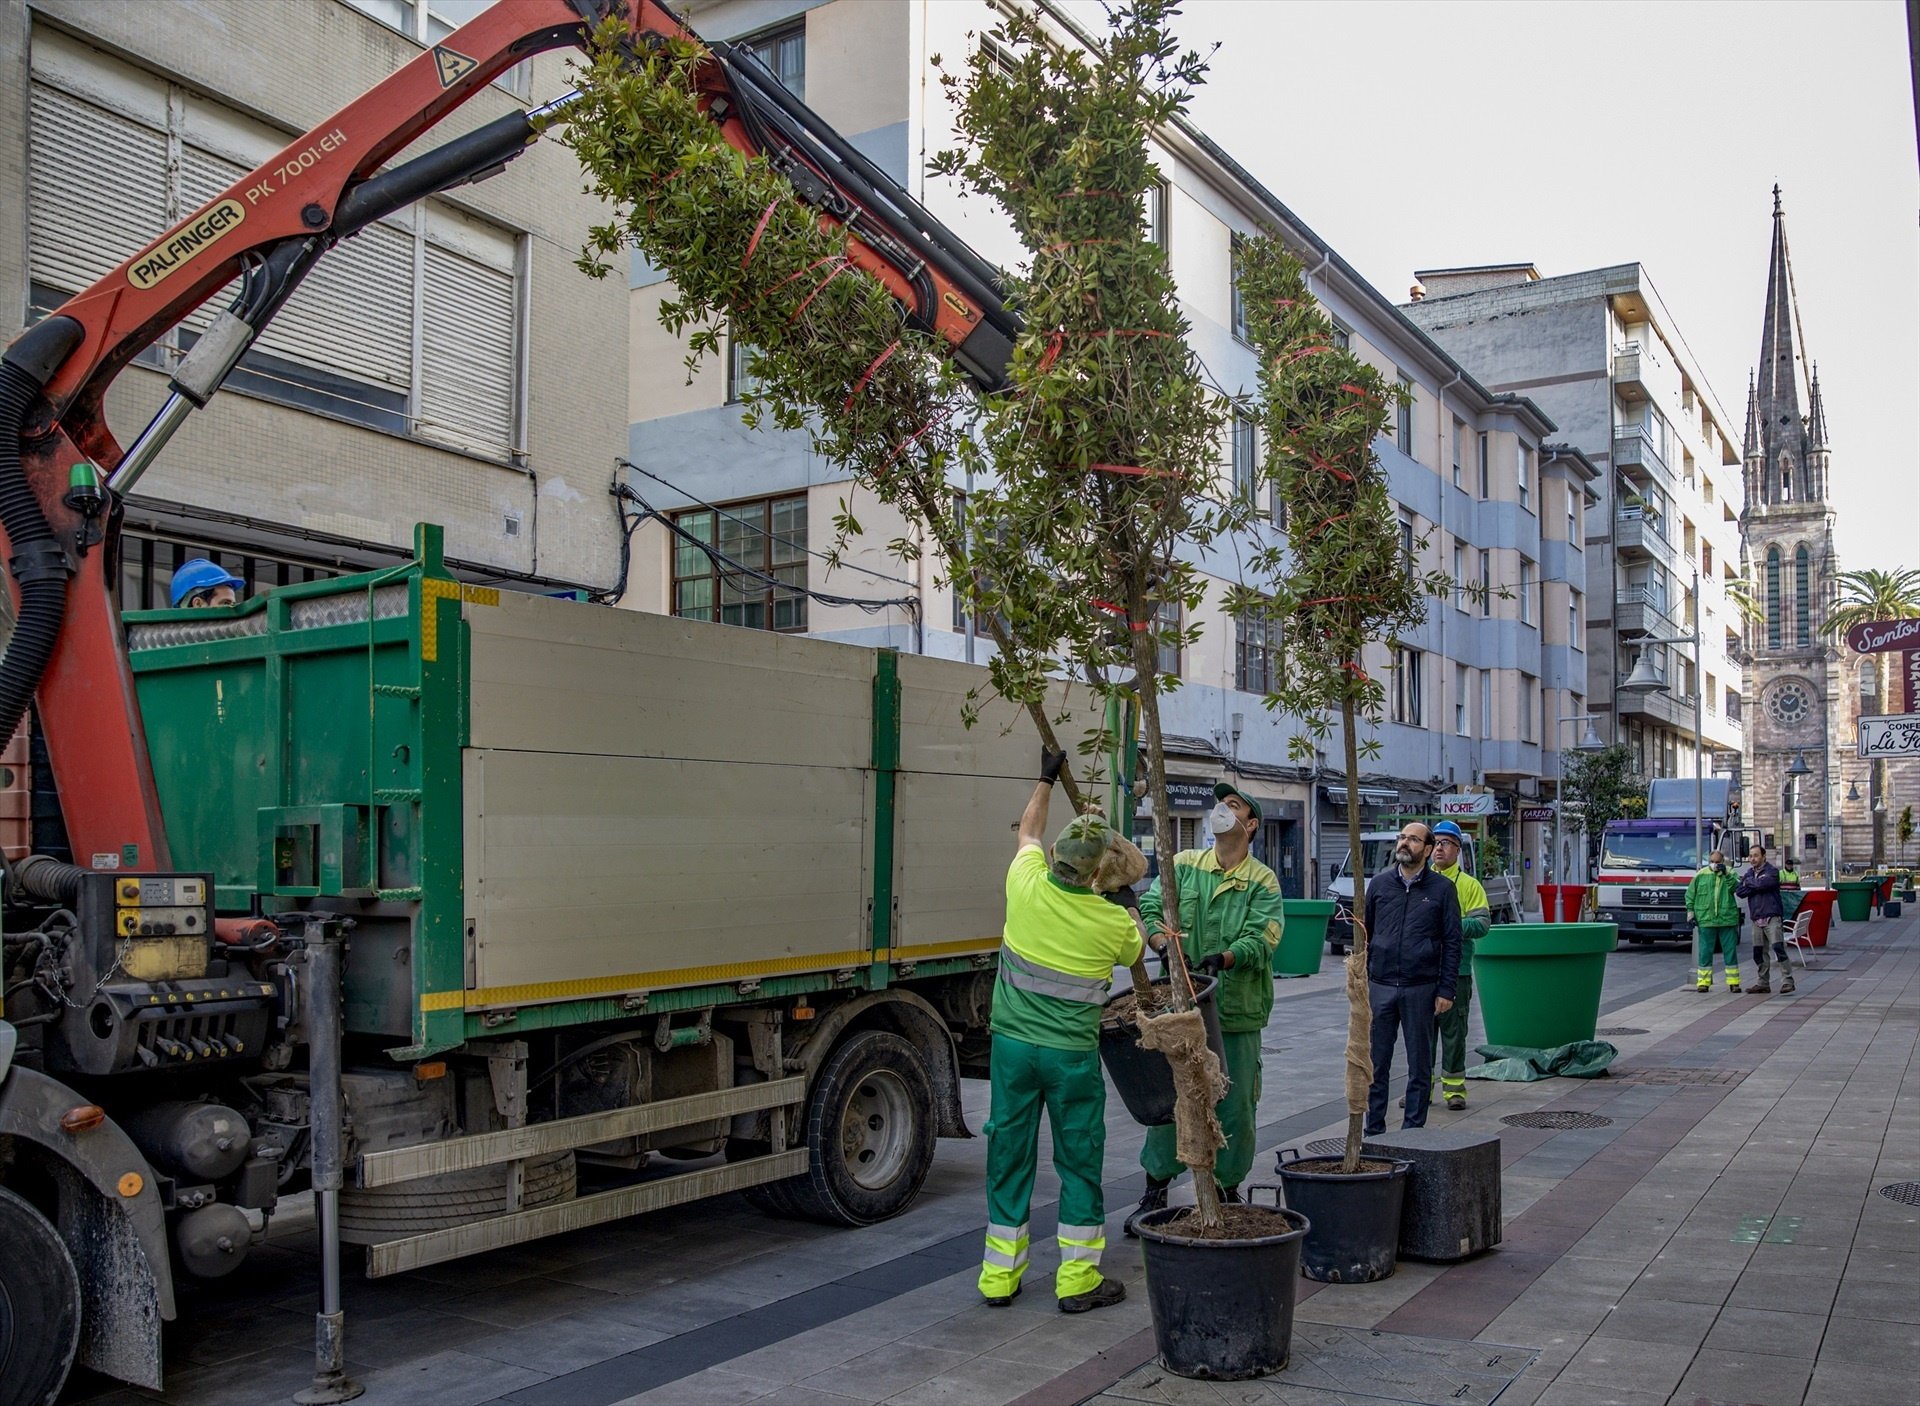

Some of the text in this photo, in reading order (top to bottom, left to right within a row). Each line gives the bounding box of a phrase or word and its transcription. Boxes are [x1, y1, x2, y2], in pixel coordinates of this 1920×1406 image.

[245, 179, 275, 205] PK
[134, 205, 240, 284] PALFINGER
[1870, 731, 1896, 750] La
[1444, 803, 1474, 813] NORTE
